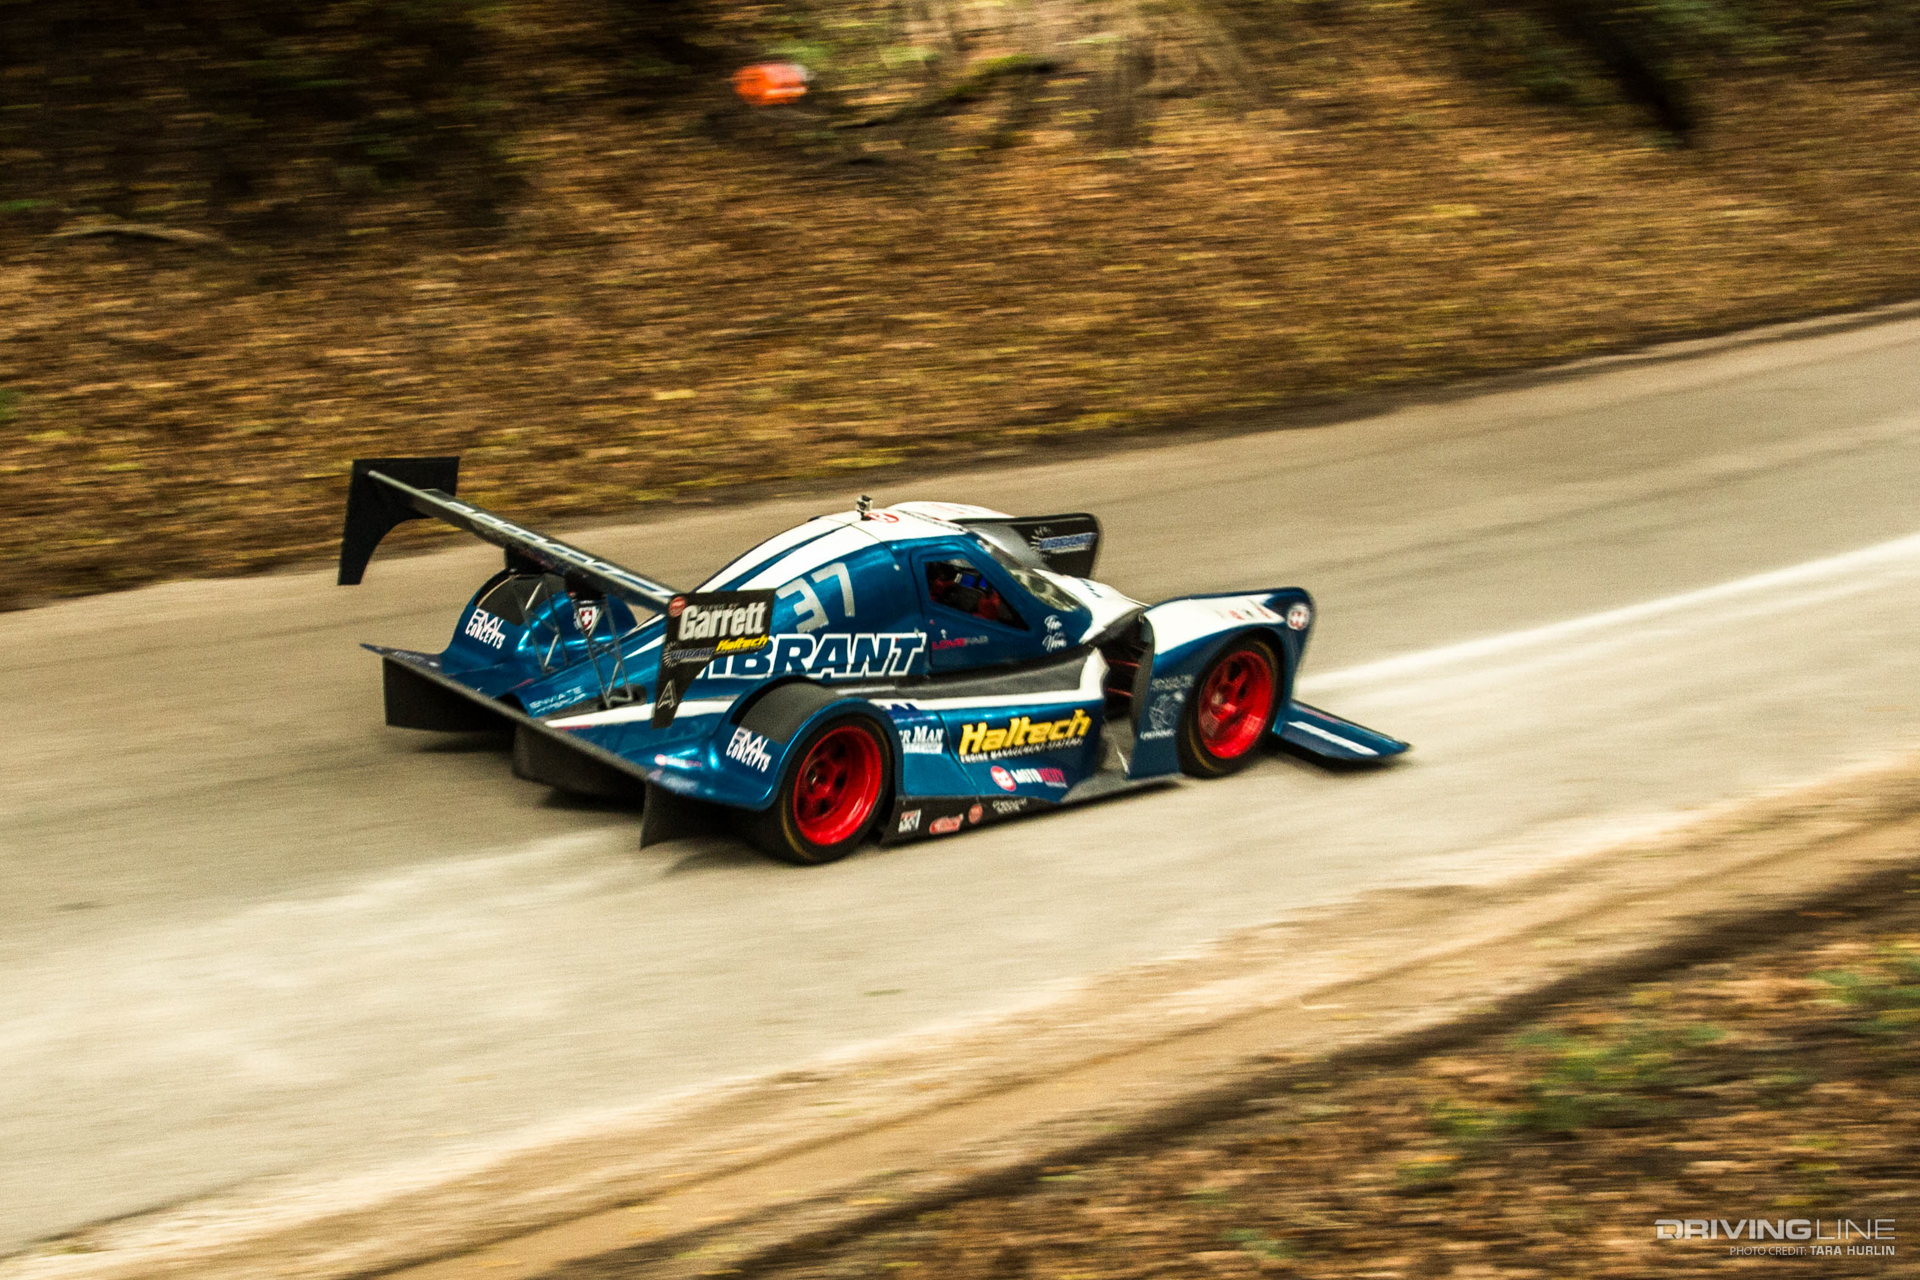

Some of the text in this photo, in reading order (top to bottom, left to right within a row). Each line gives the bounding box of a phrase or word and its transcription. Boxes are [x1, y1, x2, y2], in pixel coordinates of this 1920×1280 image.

[775, 562, 855, 634] 37
[465, 618, 506, 650] CONCEPTS
[678, 602, 767, 641] Garrett
[715, 634, 769, 652] Haltech
[958, 708, 1093, 756] Haltech
[725, 743, 772, 773] CONCEPTS
[990, 743, 1045, 760] MANAGEMENT
